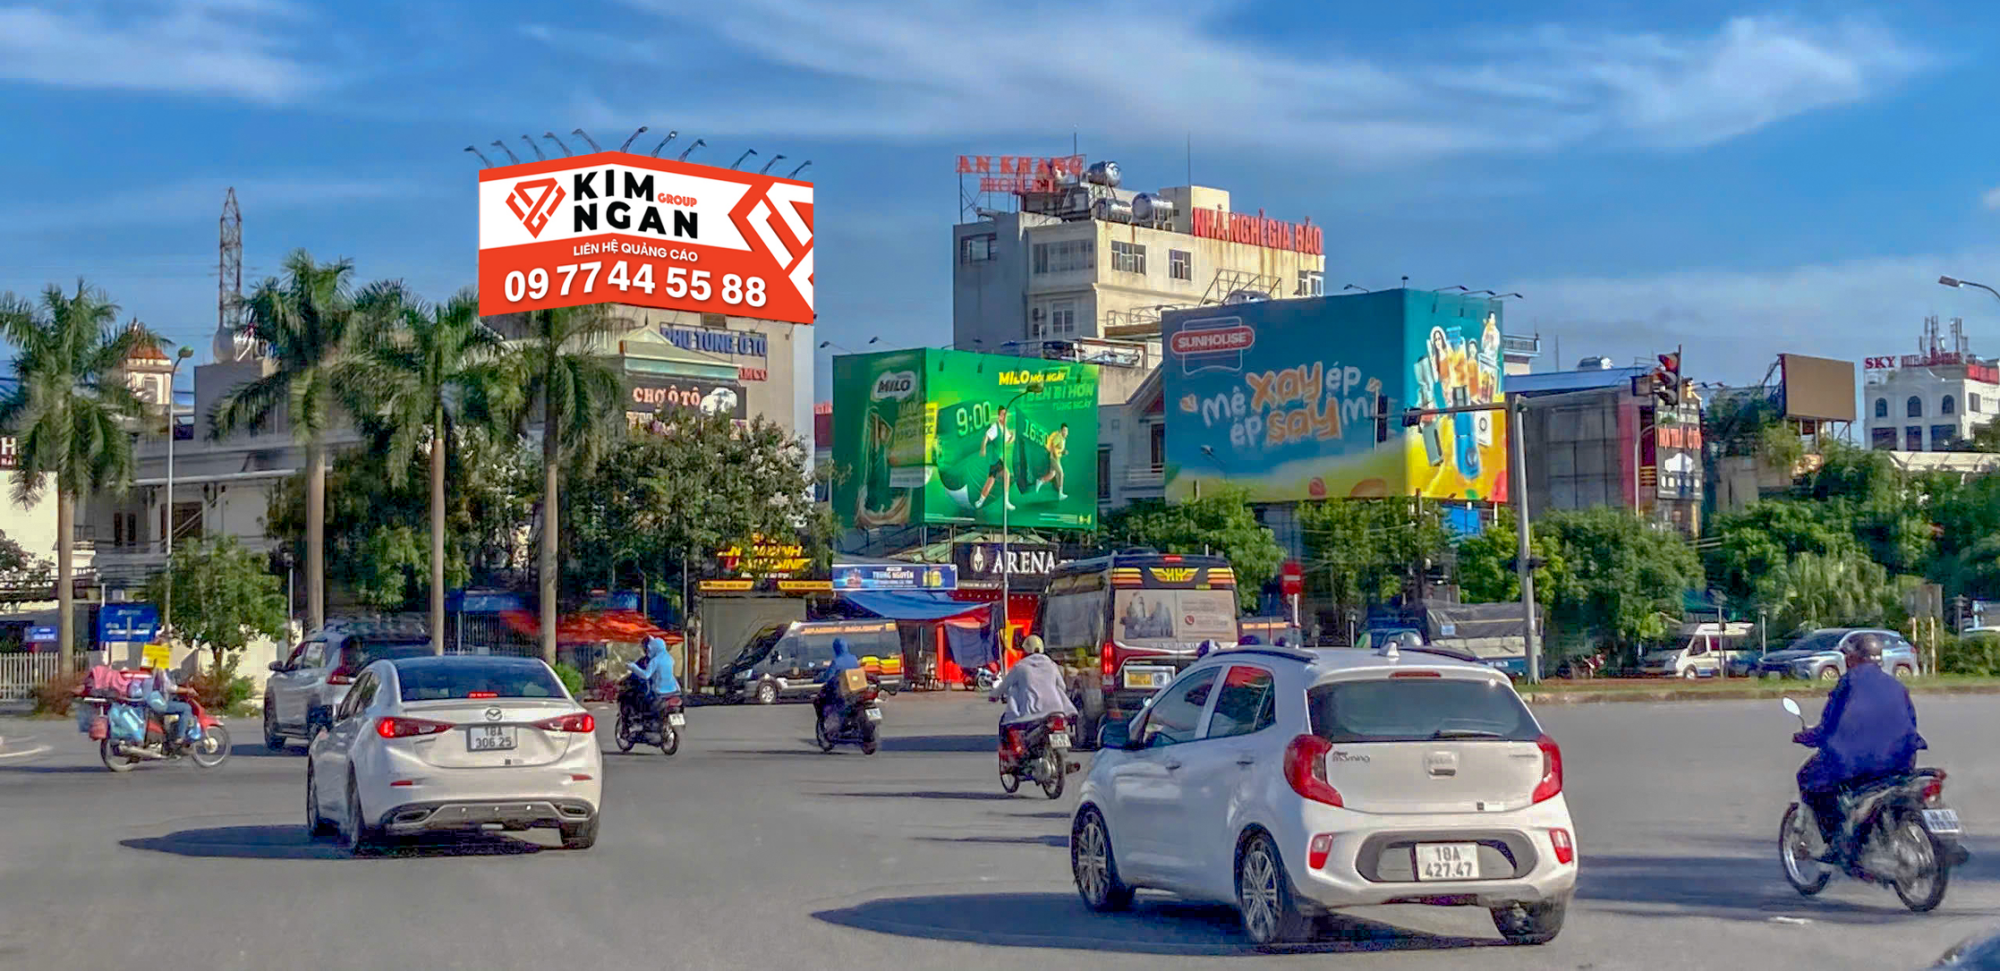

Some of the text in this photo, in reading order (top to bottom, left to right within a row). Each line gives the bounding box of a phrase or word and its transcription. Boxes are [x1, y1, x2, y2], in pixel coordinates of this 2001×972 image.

[956, 155, 990, 172] AN
[574, 169, 655, 202] KIM
[657, 192, 697, 208] GROUP
[574, 201, 698, 239] NGAN
[1267, 218, 1291, 250] GIA
[573, 239, 698, 262] LIÊN HỆ QUẢNG CÁO
[504, 260, 767, 307] 09 77 44 55 88
[1178, 332, 1247, 349] SUNHOUSE
[1865, 356, 1895, 369] SKY
[877, 379, 911, 393] MILO
[999, 370, 1030, 385] MILO
[1326, 361, 1361, 396] ép
[668, 385, 679, 403] Ô
[680, 387, 700, 406] TÔ
[956, 400, 991, 436] 9:00
[992, 550, 1055, 574] ARENA
[484, 726, 503, 737] 18A
[1435, 847, 1461, 861] 18A
[1425, 863, 1473, 878] 427.47
